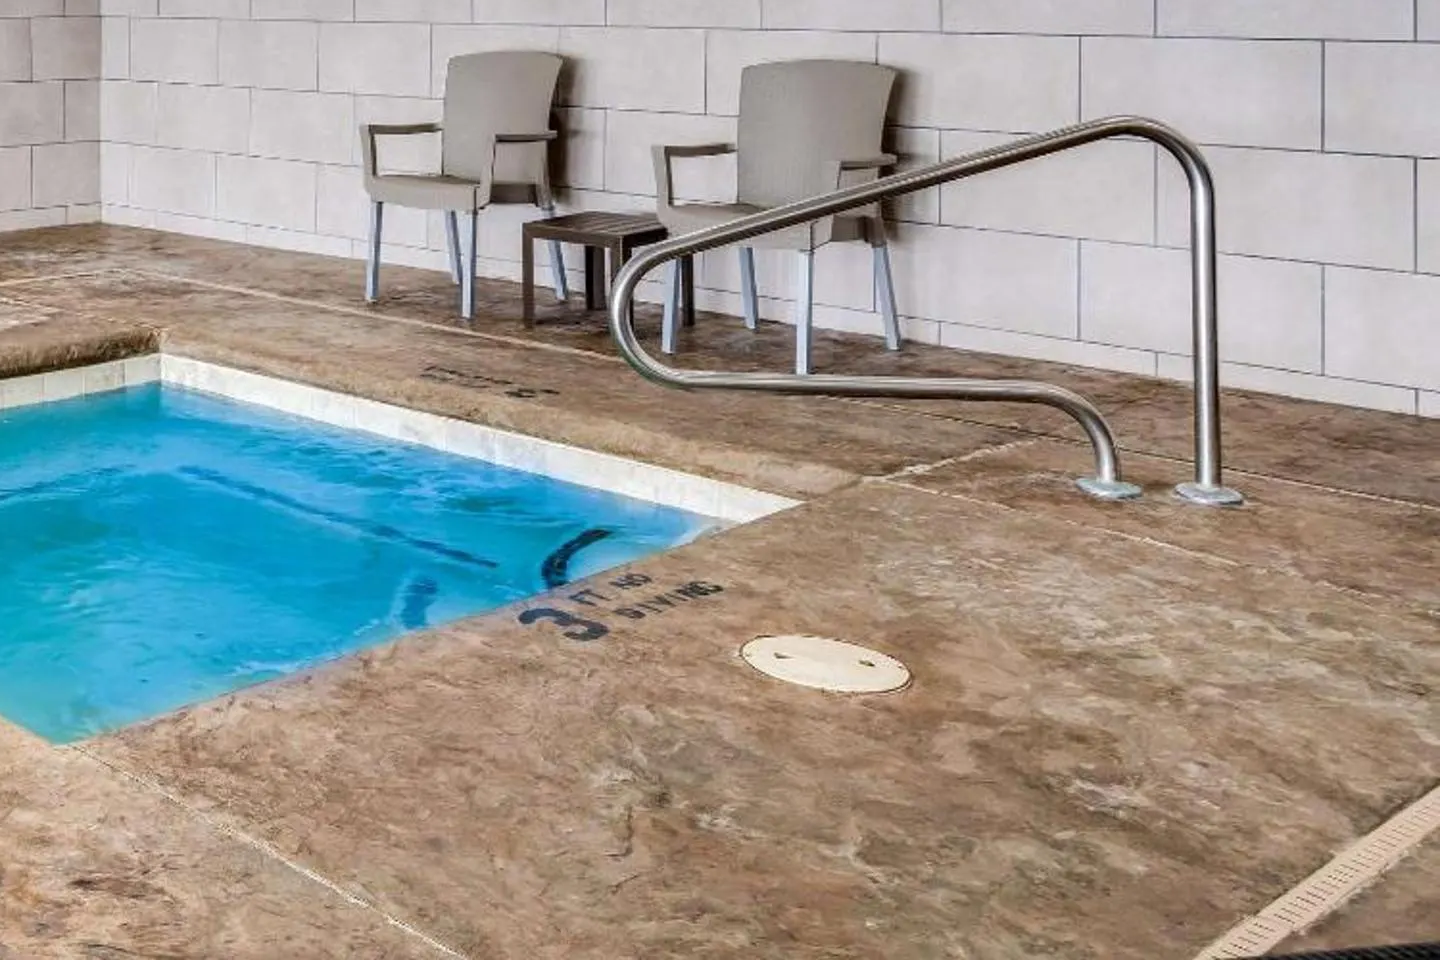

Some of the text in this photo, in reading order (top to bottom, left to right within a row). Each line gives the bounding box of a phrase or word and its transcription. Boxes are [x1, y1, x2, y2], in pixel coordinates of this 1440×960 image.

[518, 573, 652, 642] 3 FT NO
[612, 580, 724, 620] DIVING
